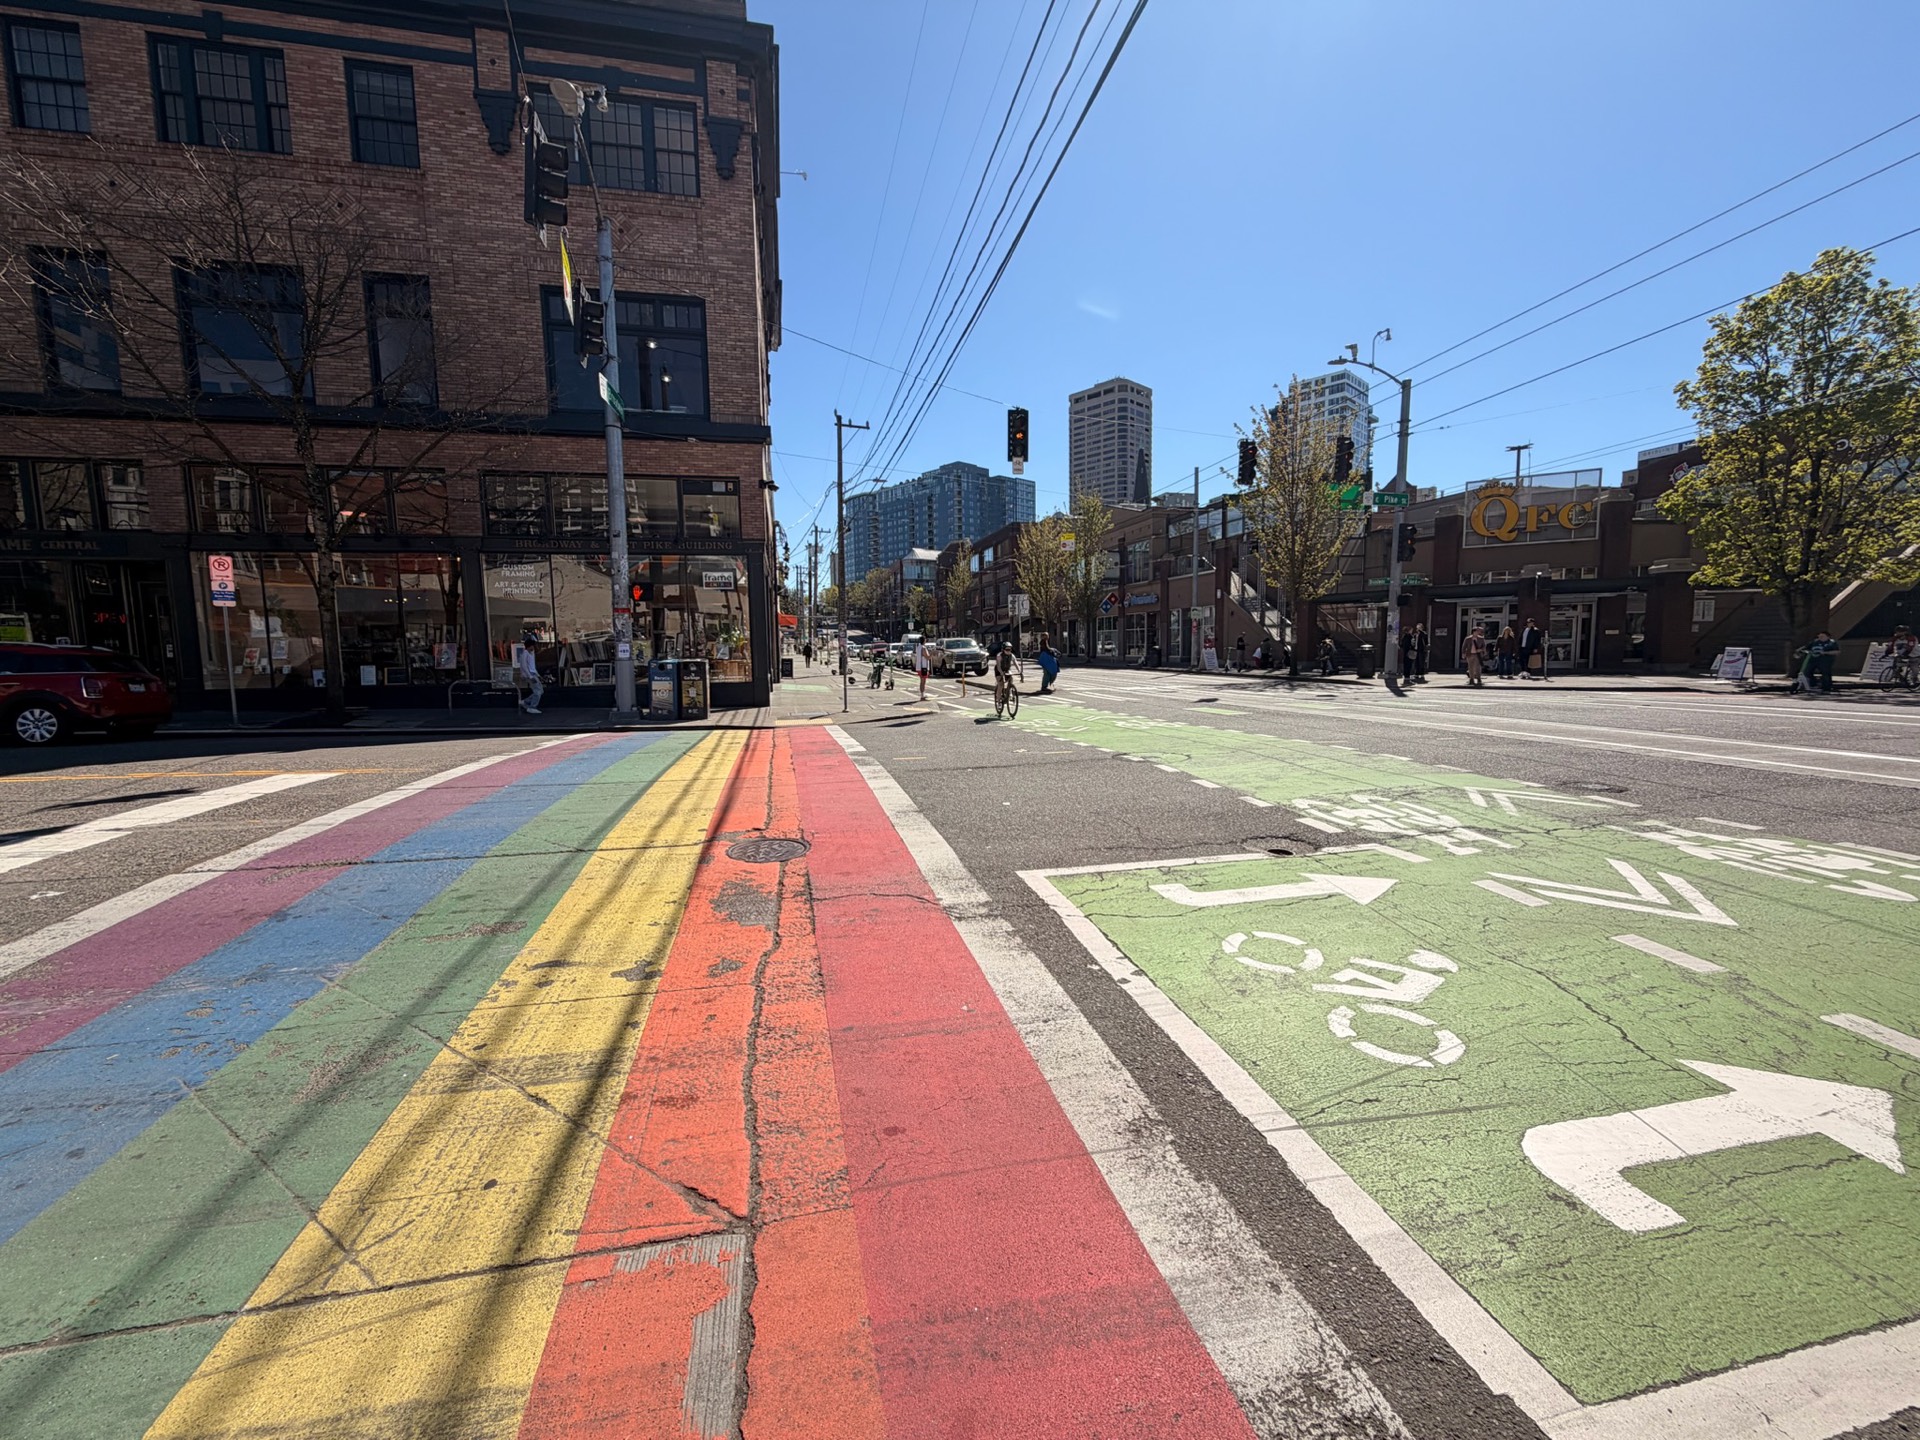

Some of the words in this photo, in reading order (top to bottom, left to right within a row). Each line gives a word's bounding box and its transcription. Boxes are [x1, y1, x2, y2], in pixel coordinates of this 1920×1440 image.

[1384, 495, 1398, 504] Pike
[1470, 496, 1594, 543] QFC
[40, 540, 101, 550] CENTRAL
[643, 541, 672, 549] PIKE
[501, 570, 536, 578] FRAMING
[704, 573, 732, 582] frame
[519, 581, 545, 589] PHOTO
